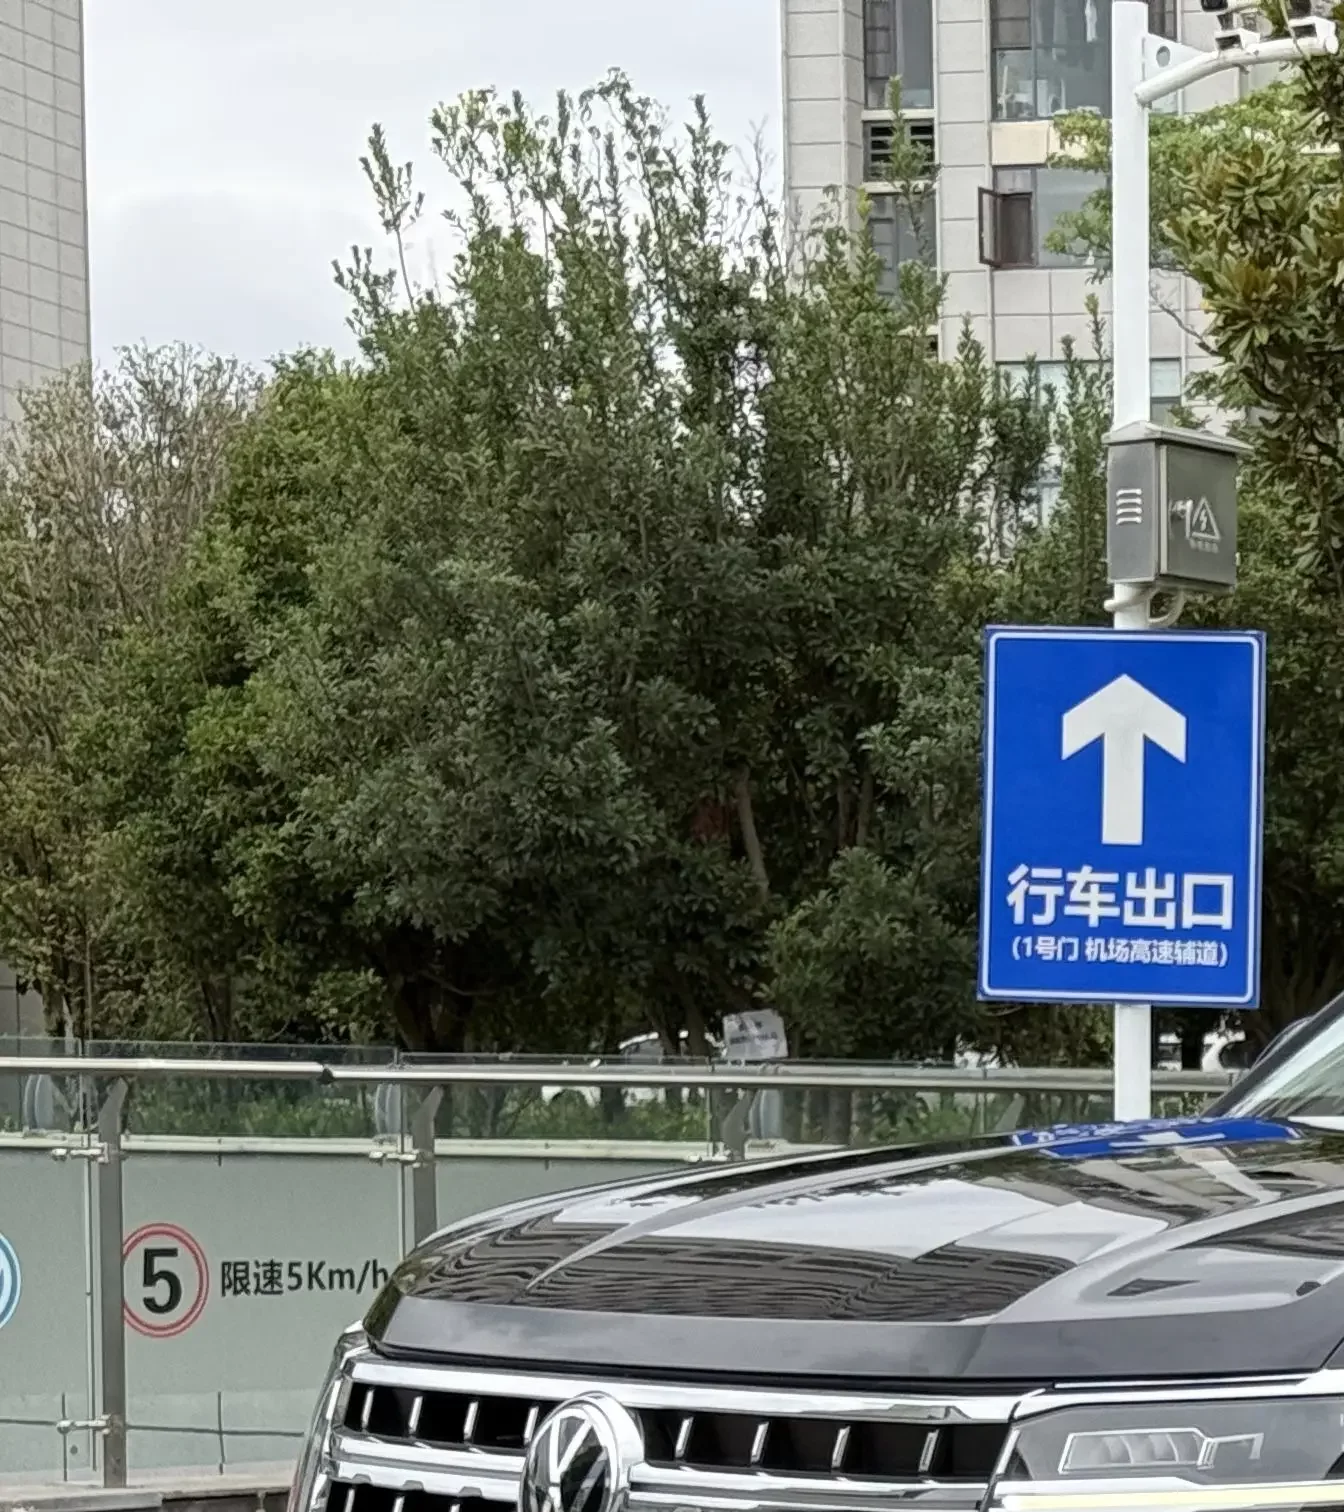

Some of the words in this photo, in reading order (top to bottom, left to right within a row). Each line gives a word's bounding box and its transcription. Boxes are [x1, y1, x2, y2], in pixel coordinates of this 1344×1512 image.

[1006, 864, 1234, 930] 行车出口
[1012, 936, 1079, 961] (1号门
[142, 1248, 182, 1314] 5
[220, 1259, 389, 1297] 限速5Km/h
